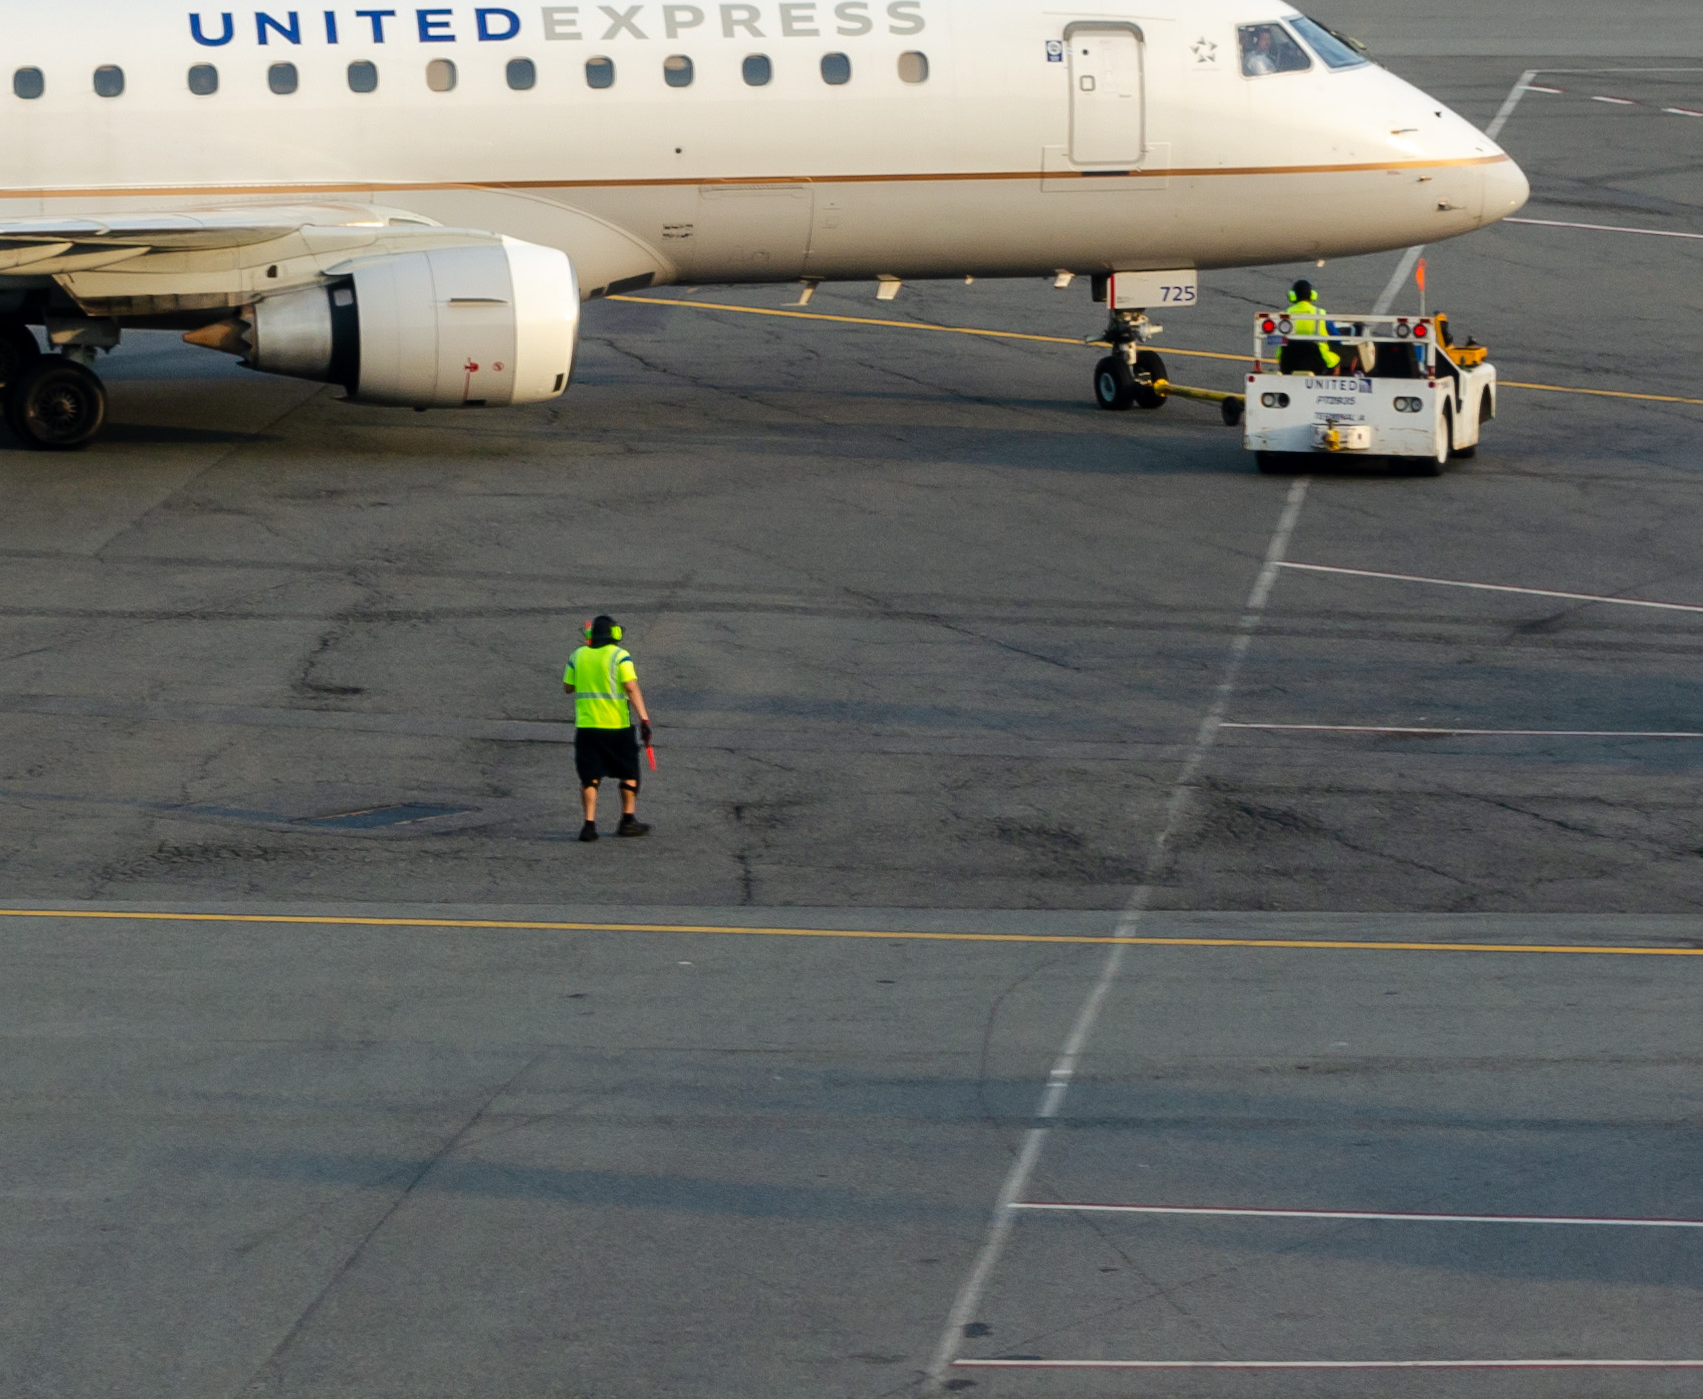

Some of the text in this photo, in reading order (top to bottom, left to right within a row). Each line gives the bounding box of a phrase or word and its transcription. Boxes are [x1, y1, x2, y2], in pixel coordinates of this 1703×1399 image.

[189, 0, 926, 46] UNITED EXPRESS
[1160, 285, 1196, 302] 725
[1304, 378, 1358, 391] UNITED
